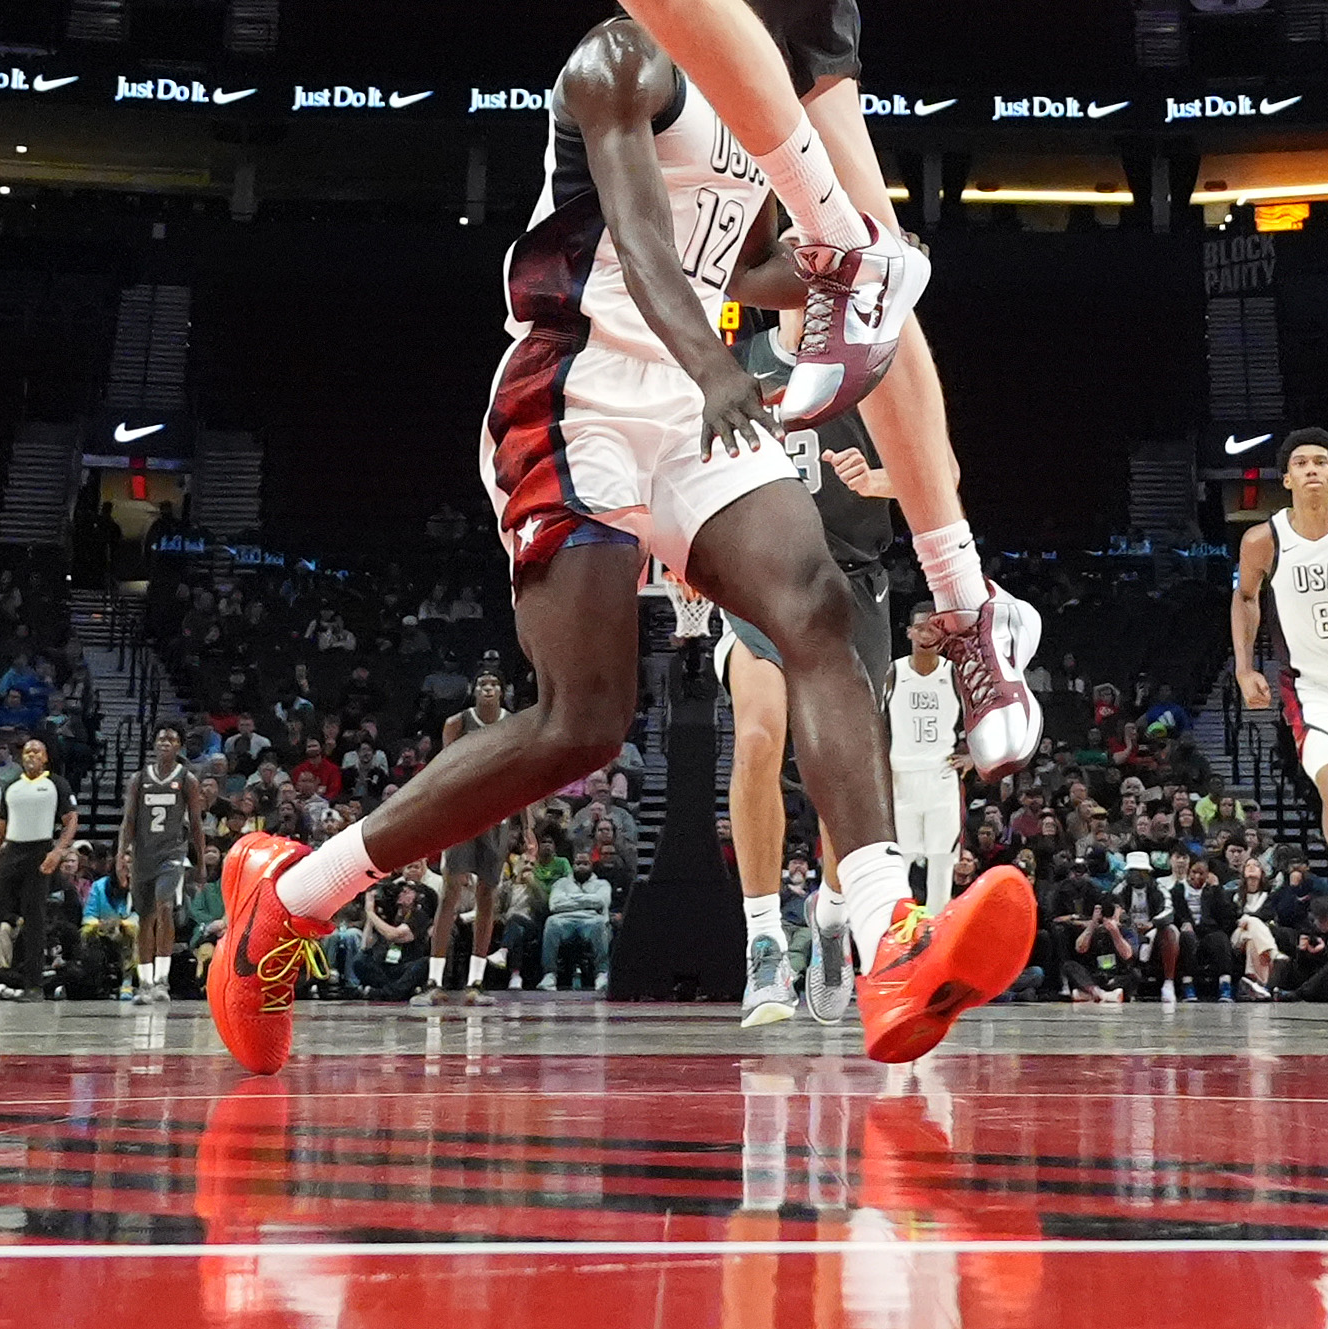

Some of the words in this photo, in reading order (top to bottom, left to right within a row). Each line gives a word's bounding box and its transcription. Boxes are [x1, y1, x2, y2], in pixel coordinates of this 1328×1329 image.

[10, 67, 30, 90] It.
[114, 75, 155, 101] Just
[156, 78, 190, 102] Do
[191, 81, 210, 103] It.
[291, 85, 332, 111] Just
[333, 85, 367, 108] Do
[367, 86, 386, 108] It.
[468, 87, 508, 113] Just
[509, 88, 543, 110] Do
[859, 92, 892, 116] Do
[892, 94, 911, 116] It.
[992, 96, 1030, 121] Just
[1032, 96, 1065, 118] Do
[1065, 97, 1084, 118] It.
[1164, 97, 1202, 123] Just
[1204, 95, 1237, 117] Do
[1237, 94, 1256, 116] It.
[682, 187, 745, 291] 12
[1203, 234, 1276, 269] BLOCK
[909, 691, 940, 710] USA
[912, 715, 939, 743] 15
[149, 806, 167, 833] 2
